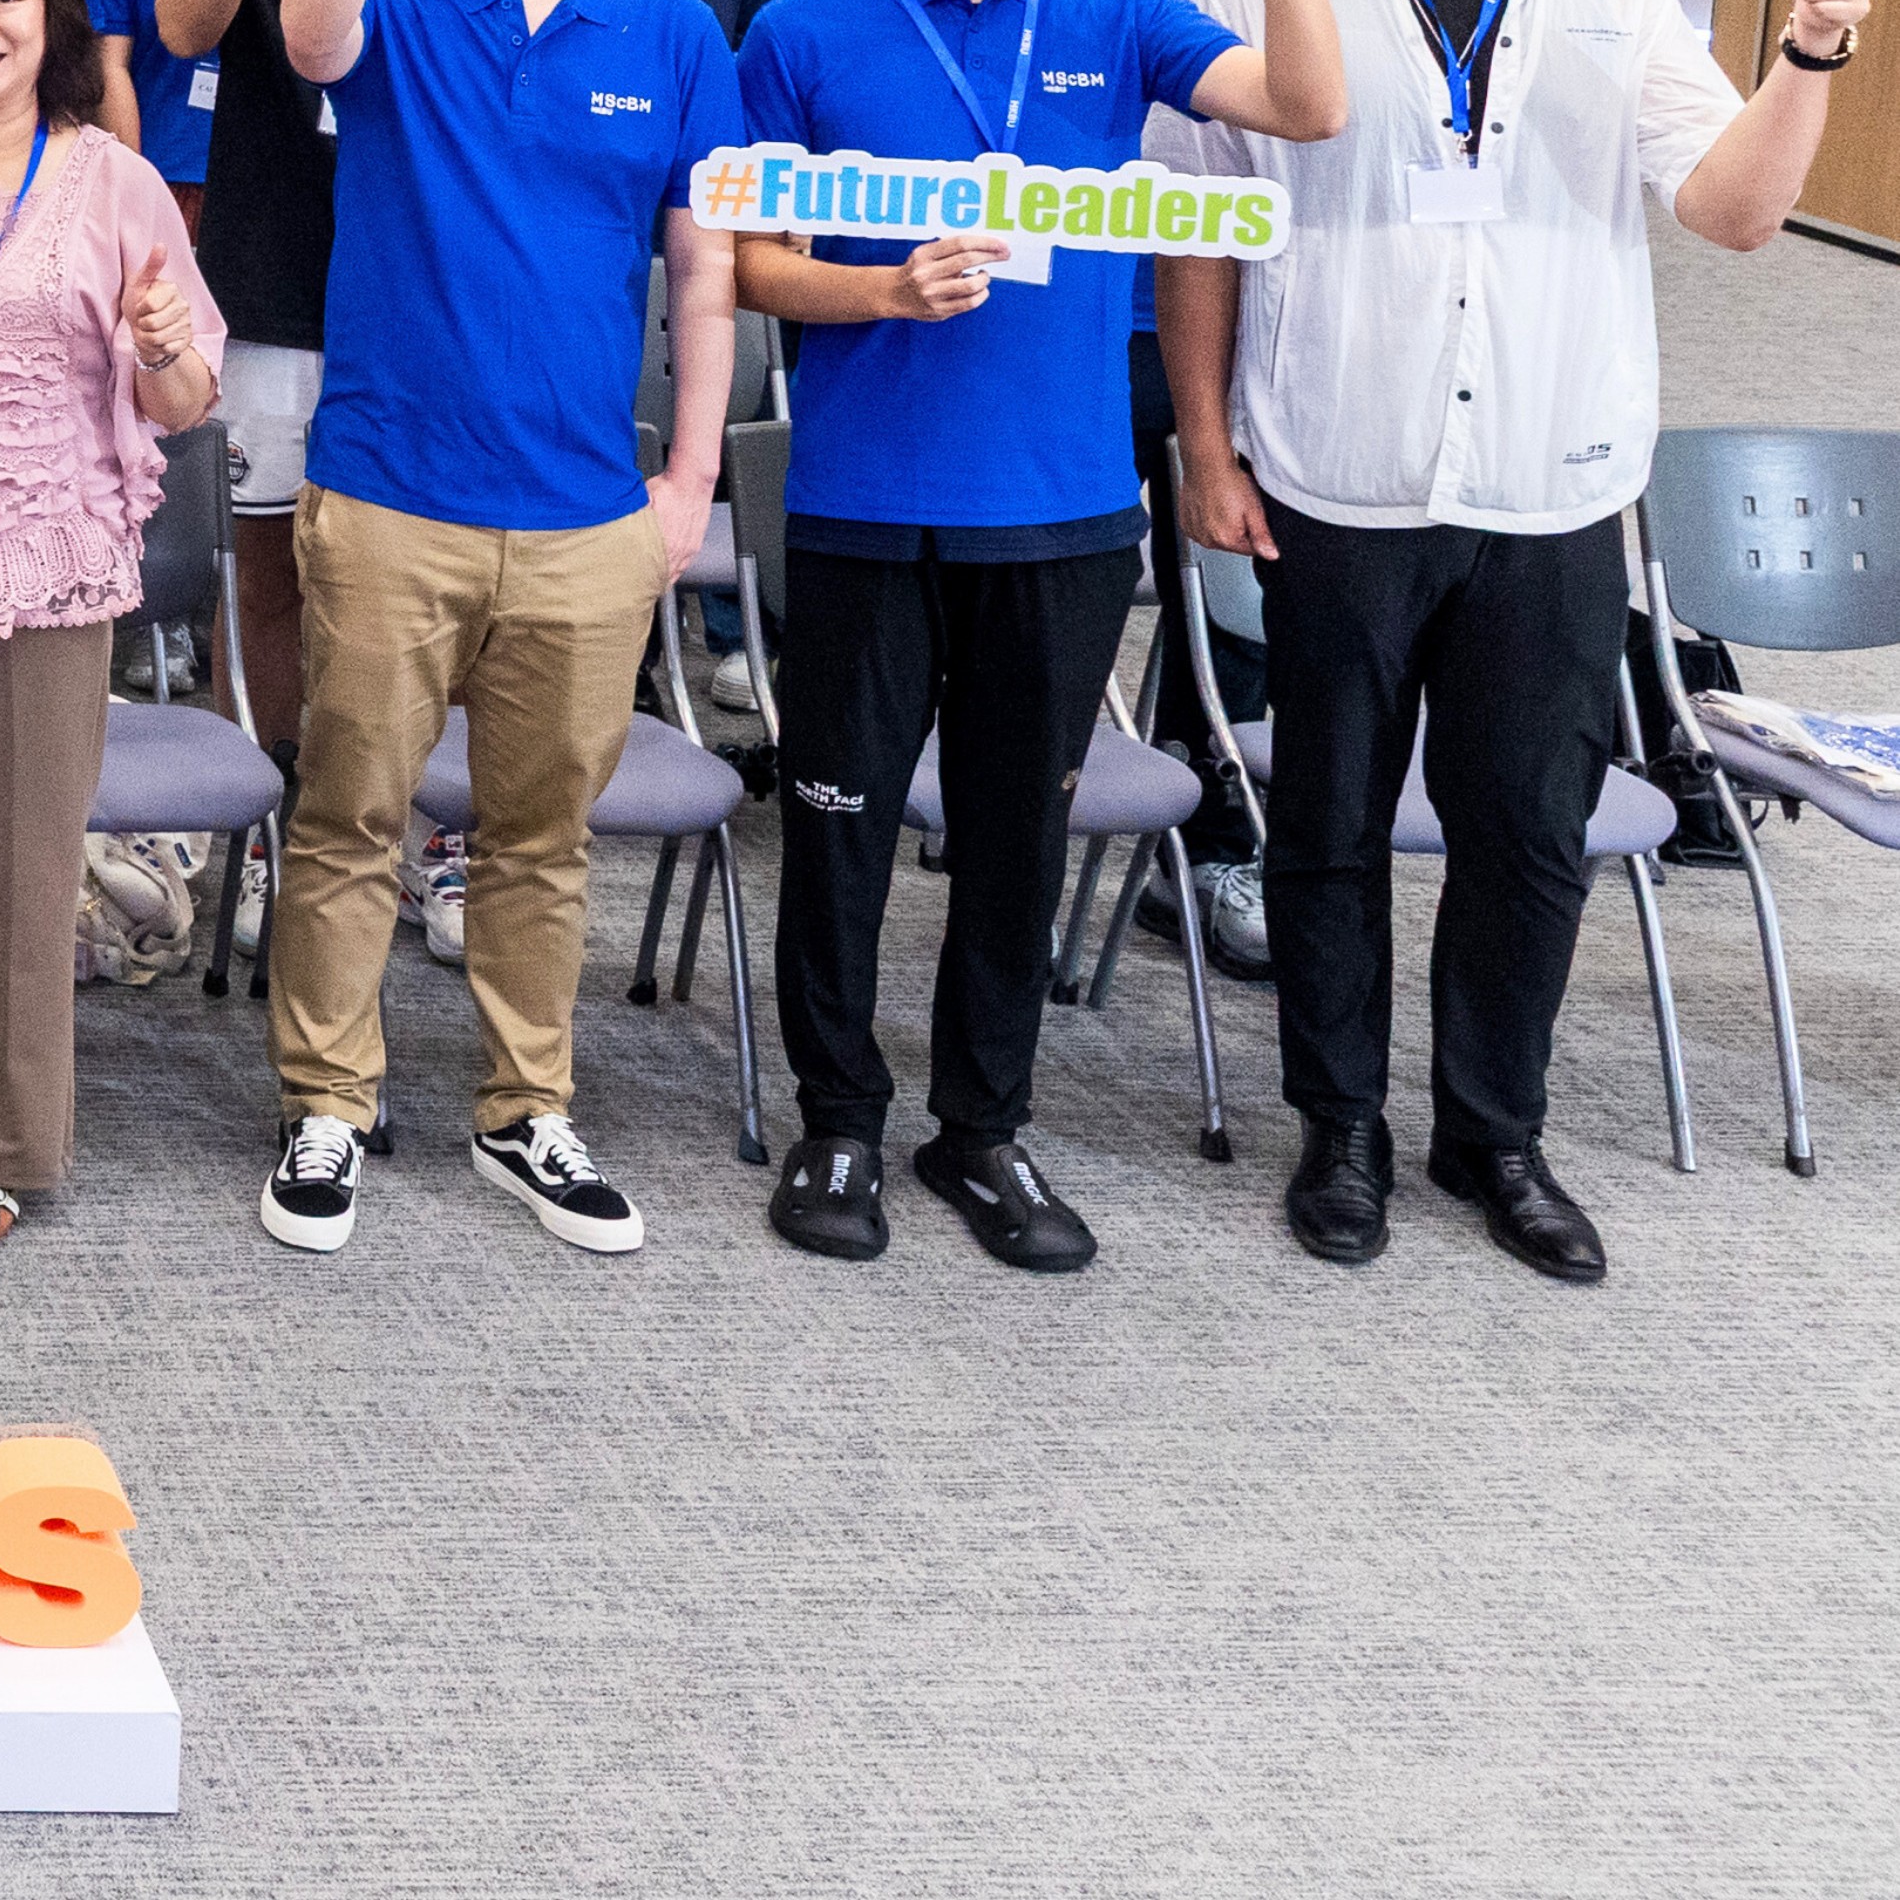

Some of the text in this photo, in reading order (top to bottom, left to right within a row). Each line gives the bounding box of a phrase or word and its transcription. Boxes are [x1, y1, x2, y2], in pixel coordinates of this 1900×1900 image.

[1040, 70, 1105, 87] MScBM
[590, 91, 652, 114] MScBM
[1006, 100, 1020, 128] HKBU
[705, 157, 1274, 247] #FutureLeaders
[812, 781, 840, 795] THE
[828, 1153, 852, 1195] MAGIC
[1012, 1161, 1050, 1208] MAGIC
